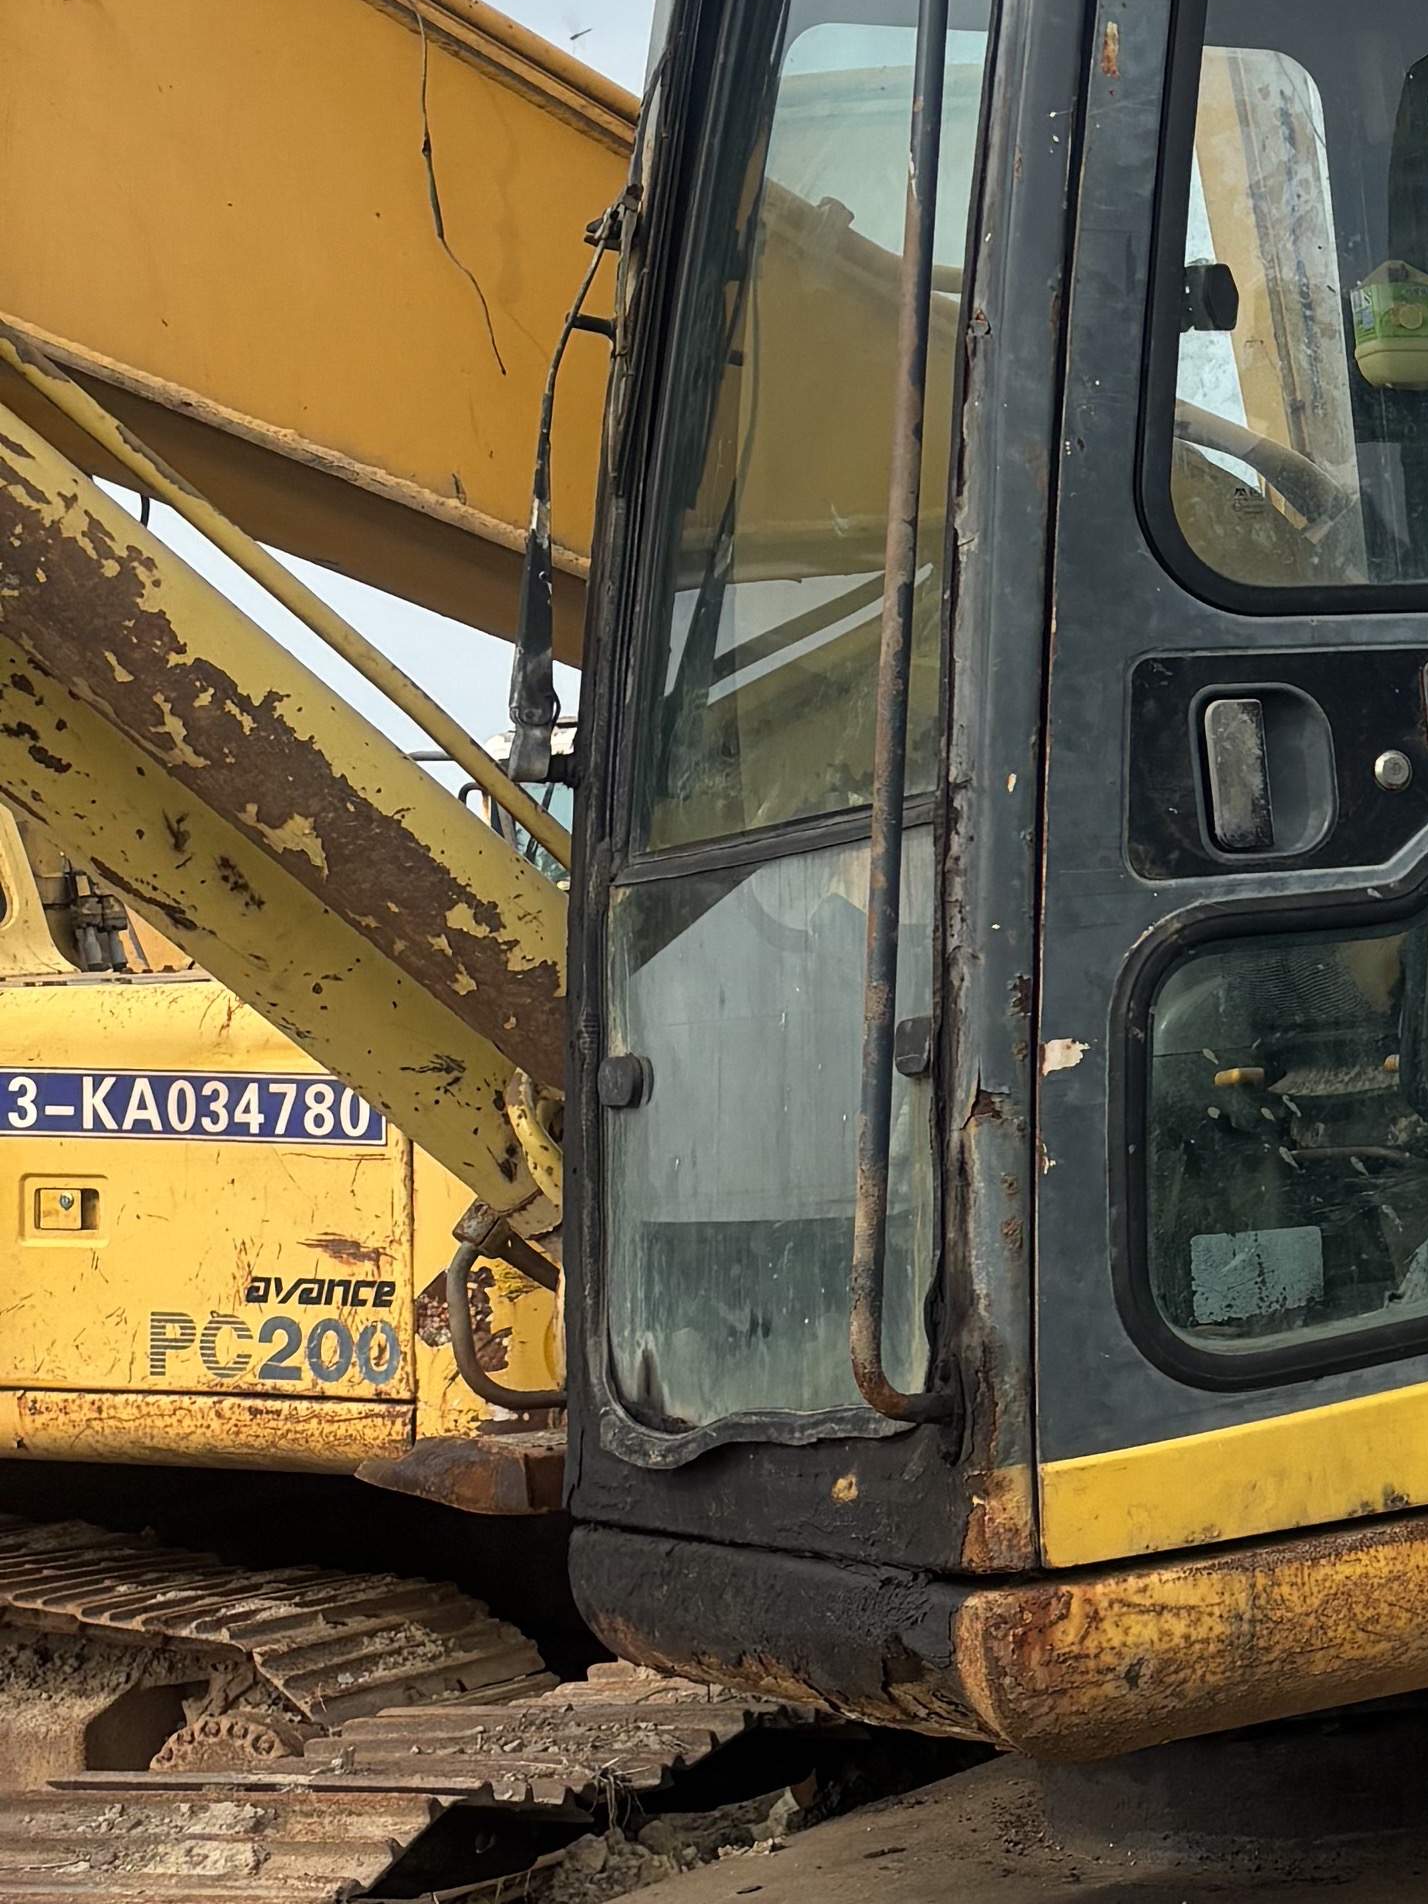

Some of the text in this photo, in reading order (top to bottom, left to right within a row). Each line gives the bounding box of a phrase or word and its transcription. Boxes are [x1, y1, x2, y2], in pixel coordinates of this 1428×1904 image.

[7, 1075, 371, 1138] 3-KA034780
[245, 1276, 395, 1308] avance
[150, 1311, 402, 1385] PC200
